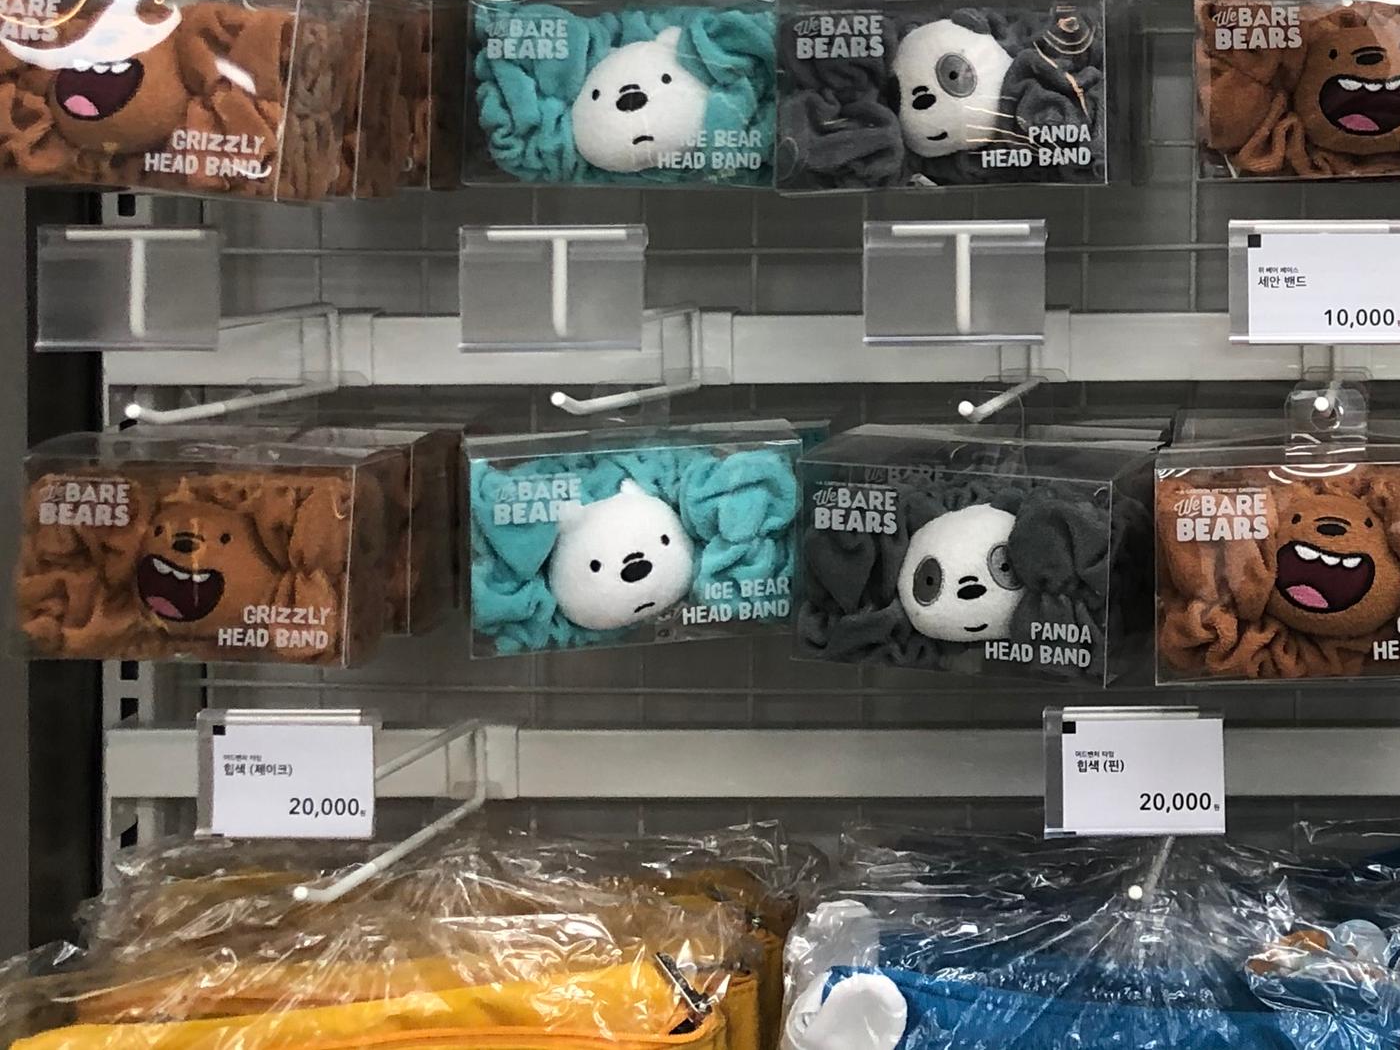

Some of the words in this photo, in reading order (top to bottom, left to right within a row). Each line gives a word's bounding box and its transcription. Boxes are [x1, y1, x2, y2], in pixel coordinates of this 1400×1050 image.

[820, 15, 884, 36] BARE
[1239, 6, 1300, 27] BARE
[509, 19, 568, 39] BARE
[1214, 27, 1302, 50] BEARS
[487, 39, 569, 60] BEARS
[796, 35, 885, 60] BEARS
[172, 130, 265, 153] GRIZZLY
[714, 130, 762, 148] BEAR
[1028, 124, 1091, 144] PANDA
[144, 152, 198, 176] HEAD
[205, 153, 262, 178] BAND
[657, 151, 705, 169] HEAD
[712, 151, 762, 169] BAND
[982, 149, 1032, 168] HEAD
[1038, 147, 1091, 166] BAND
[1258, 275, 1280, 288] 세안
[1284, 275, 1307, 288] 밴드
[65, 484, 130, 504] BARE
[518, 478, 582, 501] BARE
[812, 487, 837, 507] We
[837, 487, 897, 511] BARE
[39, 503, 130, 527] BEARS
[1174, 495, 1200, 517] We
[1201, 494, 1267, 516] BARE
[814, 507, 897, 534] BEARS
[1176, 517, 1269, 542] BEARS
[704, 581, 733, 600] ICE
[740, 577, 789, 598] BEAR
[243, 605, 331, 626] GRIZZLY
[682, 605, 732, 625] HEAD
[738, 599, 789, 621] BAND
[218, 628, 268, 647] HEAD
[276, 628, 329, 649] BAND
[1030, 621, 1092, 644] PANDA
[985, 642, 1033, 662] HEAD
[1040, 645, 1091, 668] BAND
[1077, 759, 1100, 773] 힙색
[1103, 759, 1125, 773] (핀)
